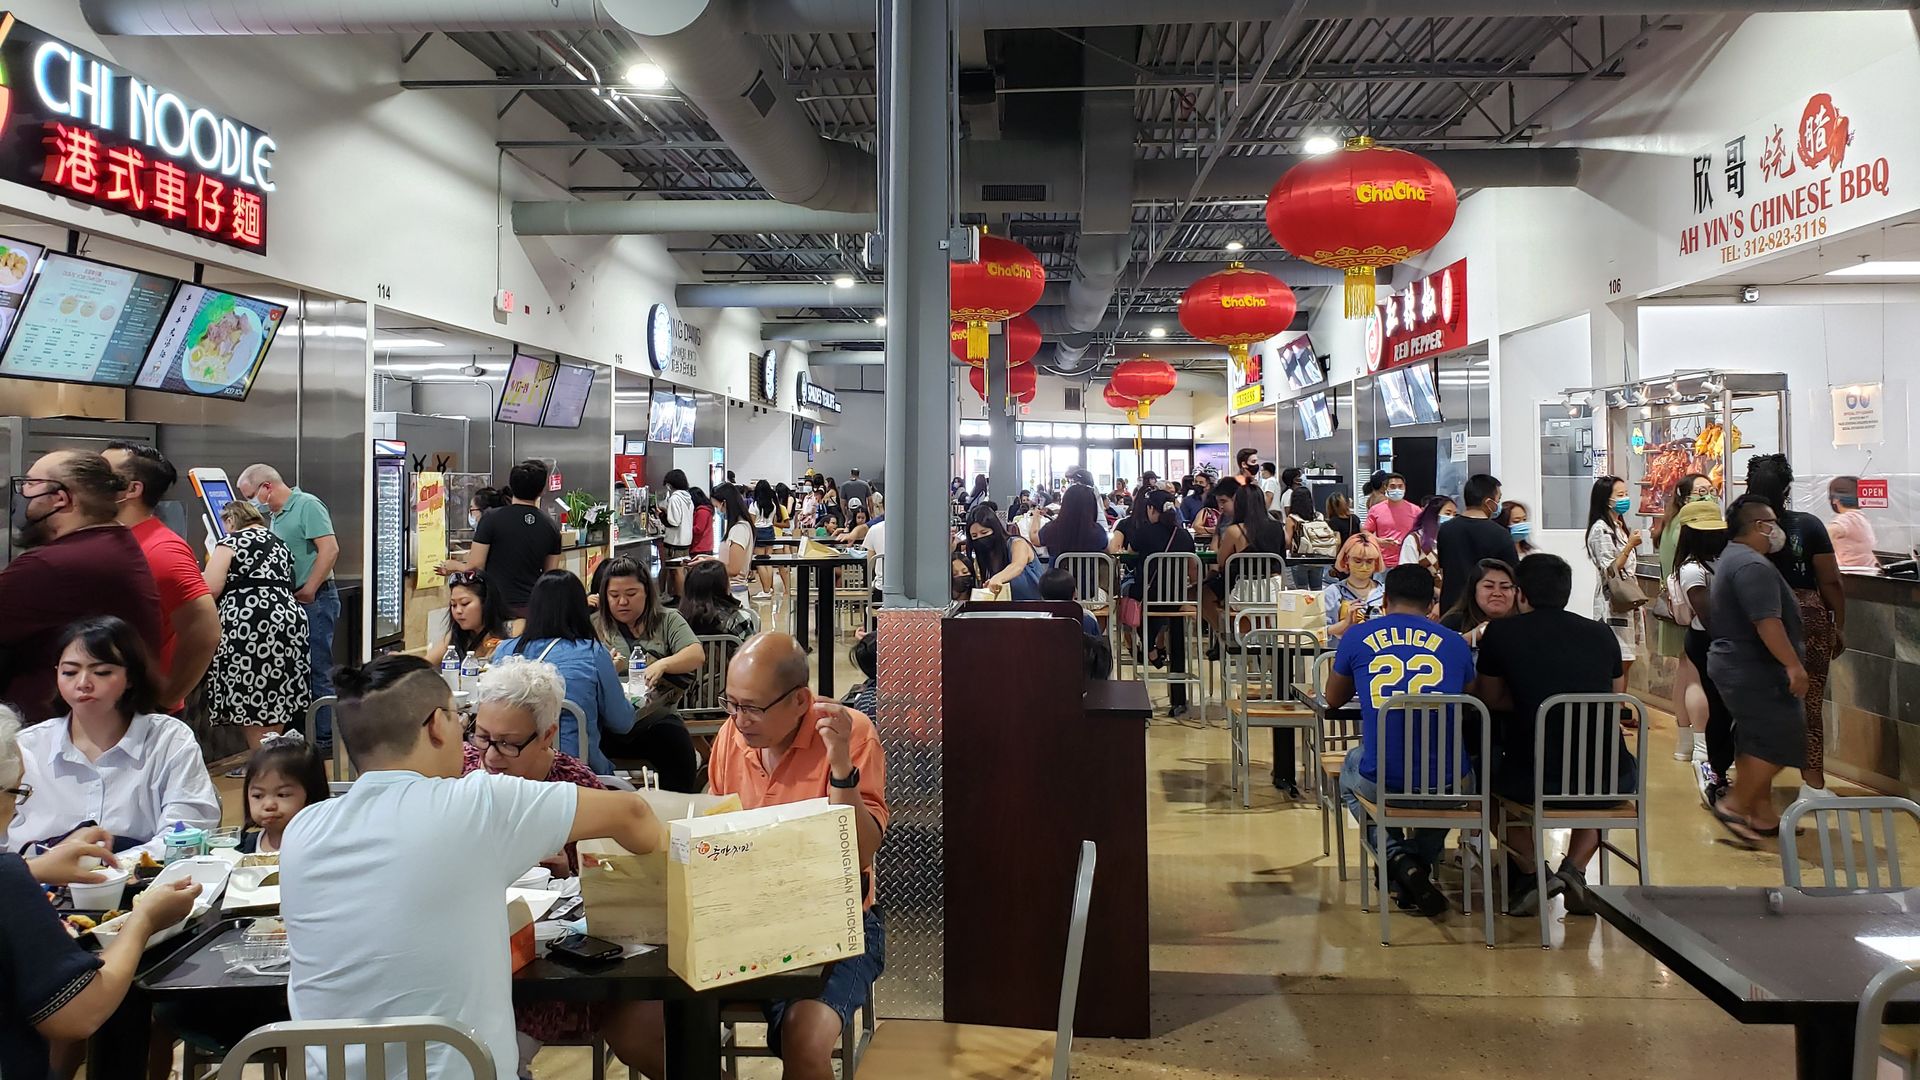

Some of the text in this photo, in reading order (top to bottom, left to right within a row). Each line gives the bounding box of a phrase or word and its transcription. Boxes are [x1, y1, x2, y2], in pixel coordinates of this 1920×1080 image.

[33, 42, 276, 192] CHI NOODLE
[48, 121, 261, 245] 港式車仔麵
[1356, 181, 1426, 203] ChaCha
[1679, 157, 1889, 256] AH YIN'S CHINESE BBQ
[1720, 216, 1828, 264] TEL: 312-823-3118
[987, 262, 1031, 279] ChaCha
[378, 283, 390, 300] 114
[1608, 279, 1622, 295] 106
[1221, 295, 1266, 309] ChaCha
[1394, 329, 1444, 362] RED PEPPER
[1862, 487, 1884, 497] OPEN
[1362, 627, 1444, 653] YELICH
[1368, 654, 1444, 709] 22
[838, 815, 857, 952] CHOONGMAN CHICKEN
